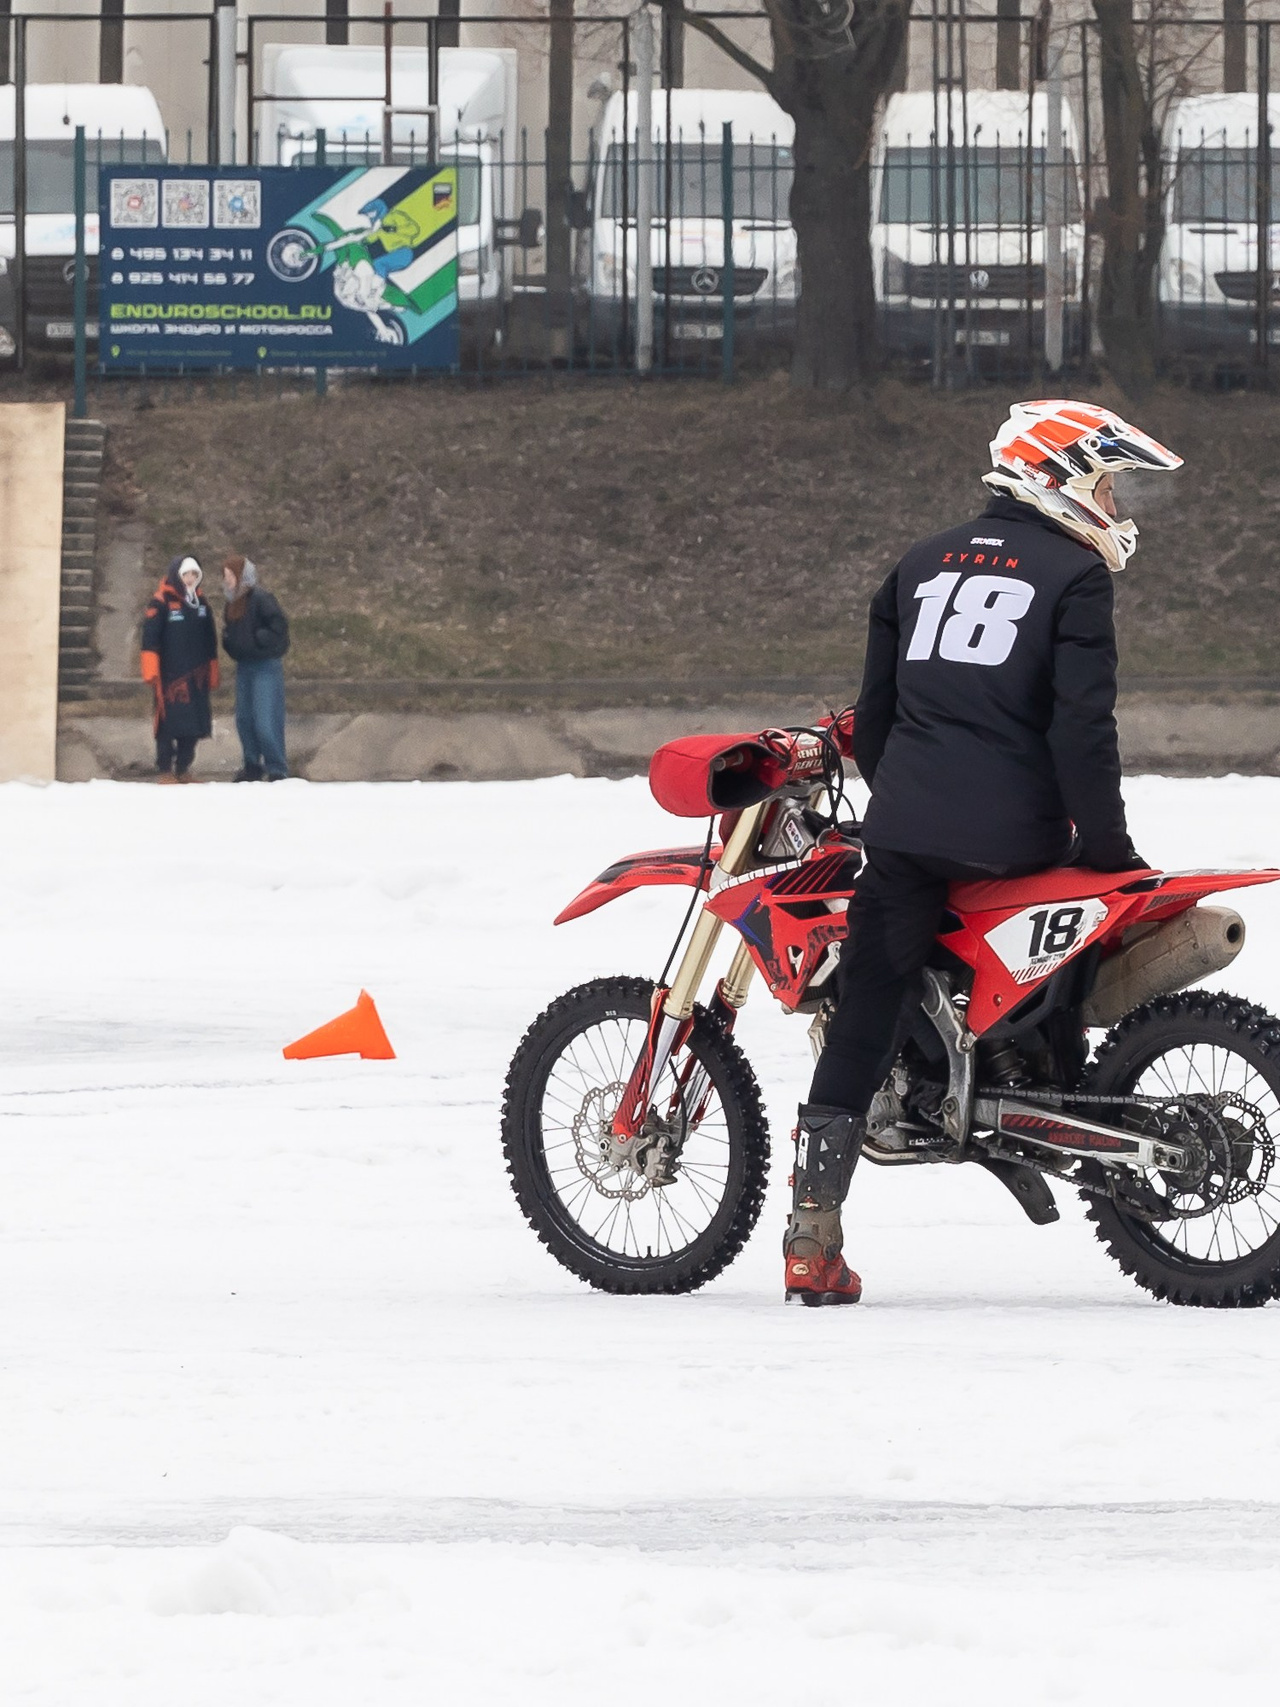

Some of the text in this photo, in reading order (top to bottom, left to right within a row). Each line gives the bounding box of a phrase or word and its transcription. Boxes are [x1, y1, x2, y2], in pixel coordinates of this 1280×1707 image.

[111, 247, 124, 260] 8
[172, 247, 204, 261] 134
[209, 247, 234, 261] 34
[240, 248, 252, 260] 11
[111, 271, 124, 285] 8
[168, 272, 198, 285] 414
[232, 272, 255, 285] 77
[111, 304, 332, 320] ENDUROSCHOOL.RU
[110, 323, 160, 335] ШКОЛА
[164, 323, 221, 336] ЭНДУРО
[225, 325, 236, 335] И
[239, 324, 333, 336] МОТОКРОССА
[942, 552, 1019, 568] ZYRIN
[906, 571, 1036, 666] 18
[1028, 906, 1085, 958] 18
